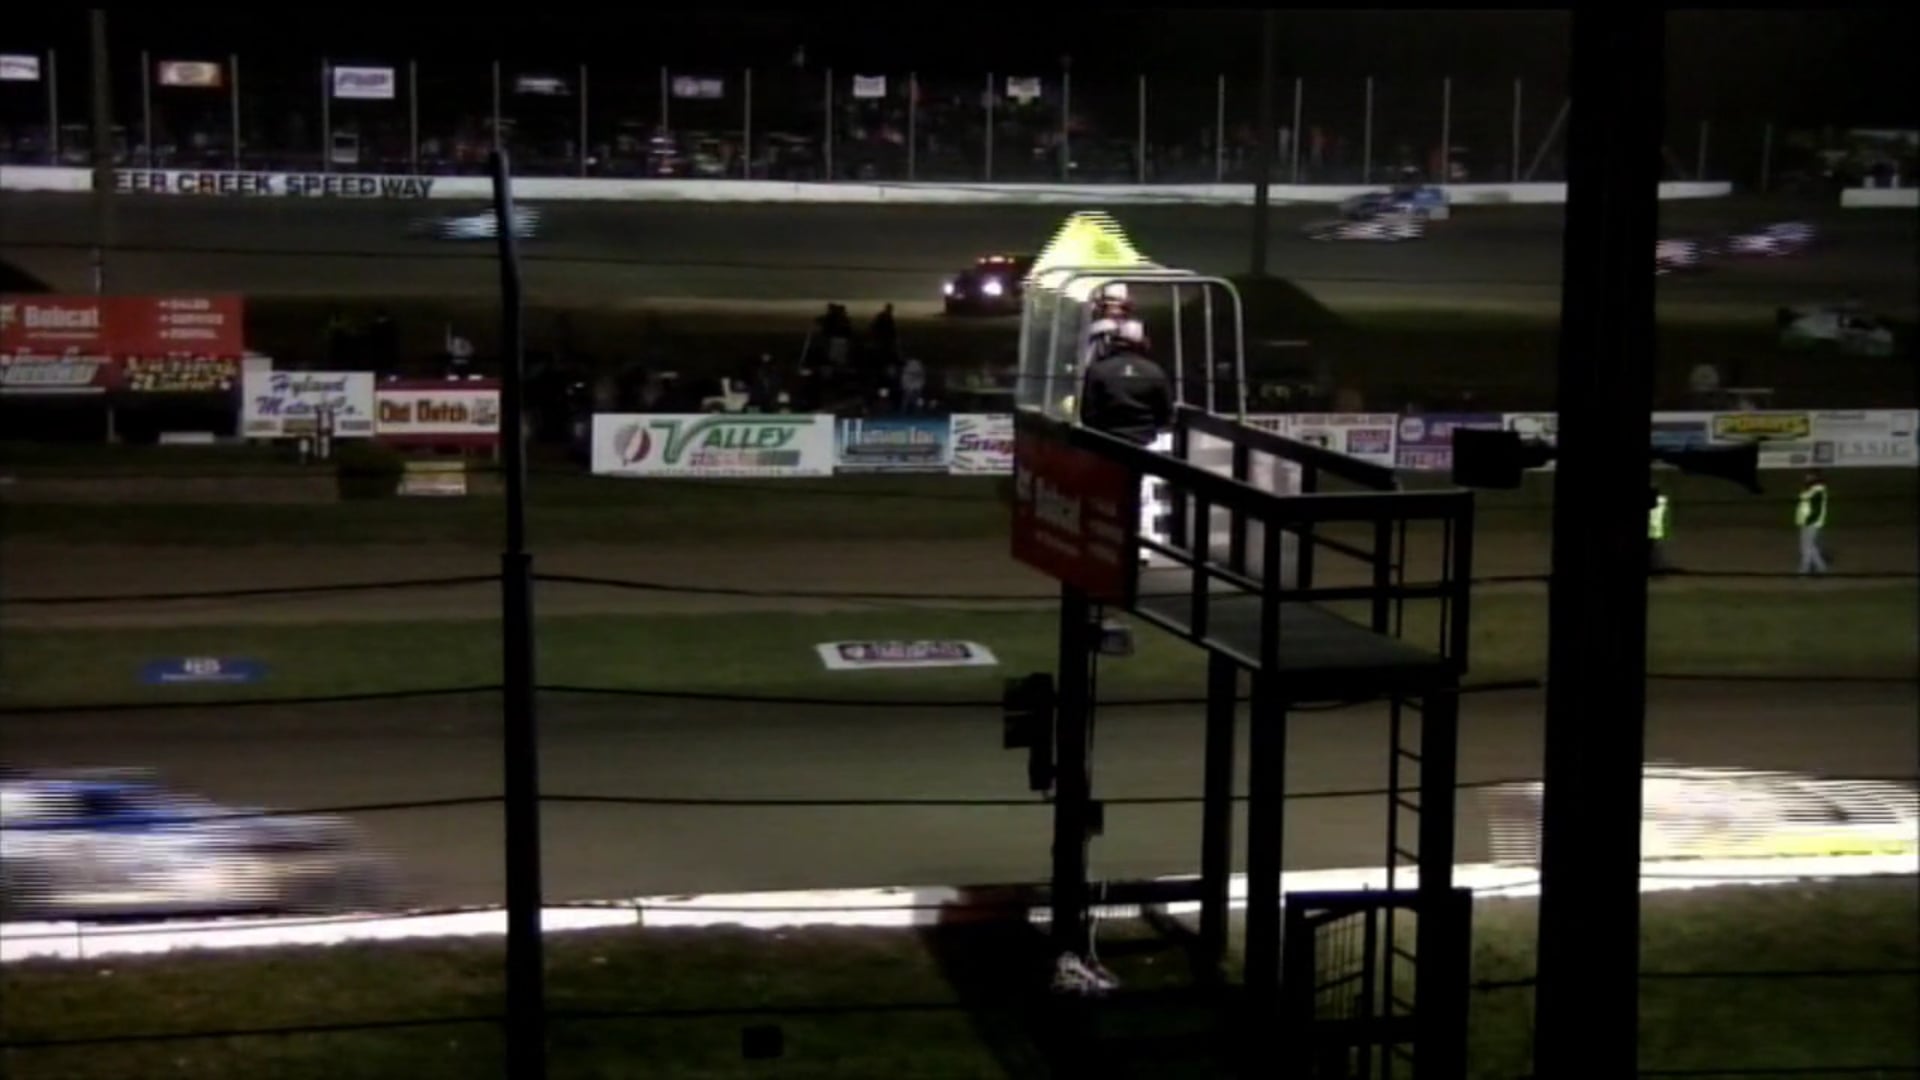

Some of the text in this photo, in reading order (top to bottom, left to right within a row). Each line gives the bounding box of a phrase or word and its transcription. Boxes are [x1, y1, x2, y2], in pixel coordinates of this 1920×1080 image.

[110, 172, 434, 198] EER CREEK SPEEDWAY
[23, 304, 100, 328] Bobcat
[416, 398, 467, 423] Dutch
[650, 414, 816, 465] VALLEY
